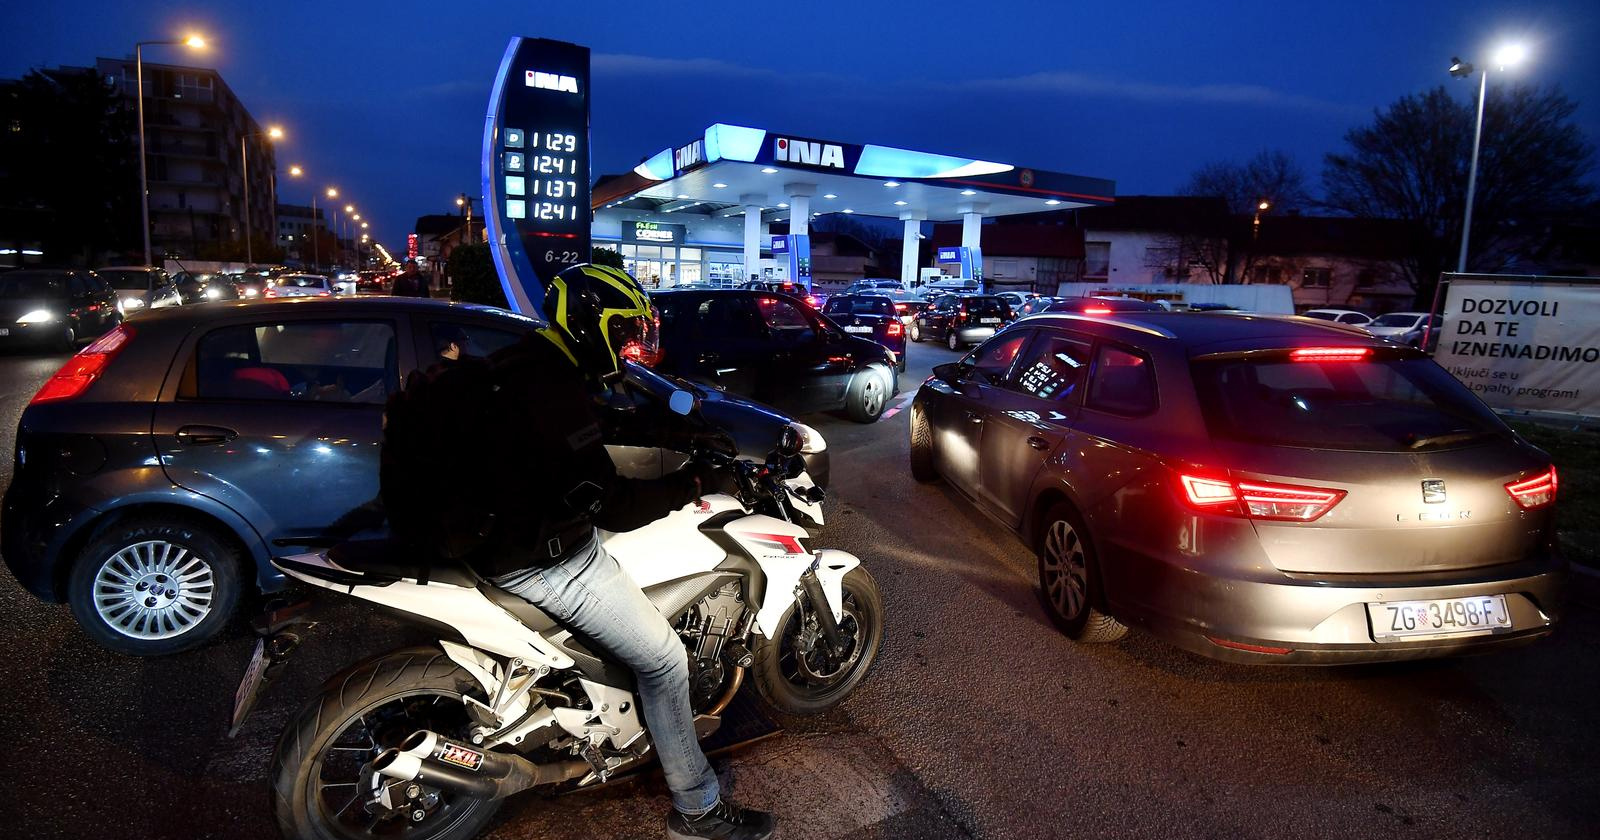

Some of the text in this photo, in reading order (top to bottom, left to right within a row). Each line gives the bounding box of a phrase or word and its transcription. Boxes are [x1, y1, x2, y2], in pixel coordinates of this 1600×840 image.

[525, 70, 578, 93] INA
[676, 140, 700, 171] INA
[776, 137, 845, 169] INA
[545, 250, 579, 263] 6-22
[1461, 298, 1559, 317] DOZVOLI
[1456, 320, 1519, 337] DA TE
[1451, 341, 1600, 363] IZNENADIMO
[1492, 371, 1507, 380] se
[1469, 381, 1514, 396] Loyalty
[1517, 386, 1580, 399] program!
[1387, 604, 1417, 631] ZG
